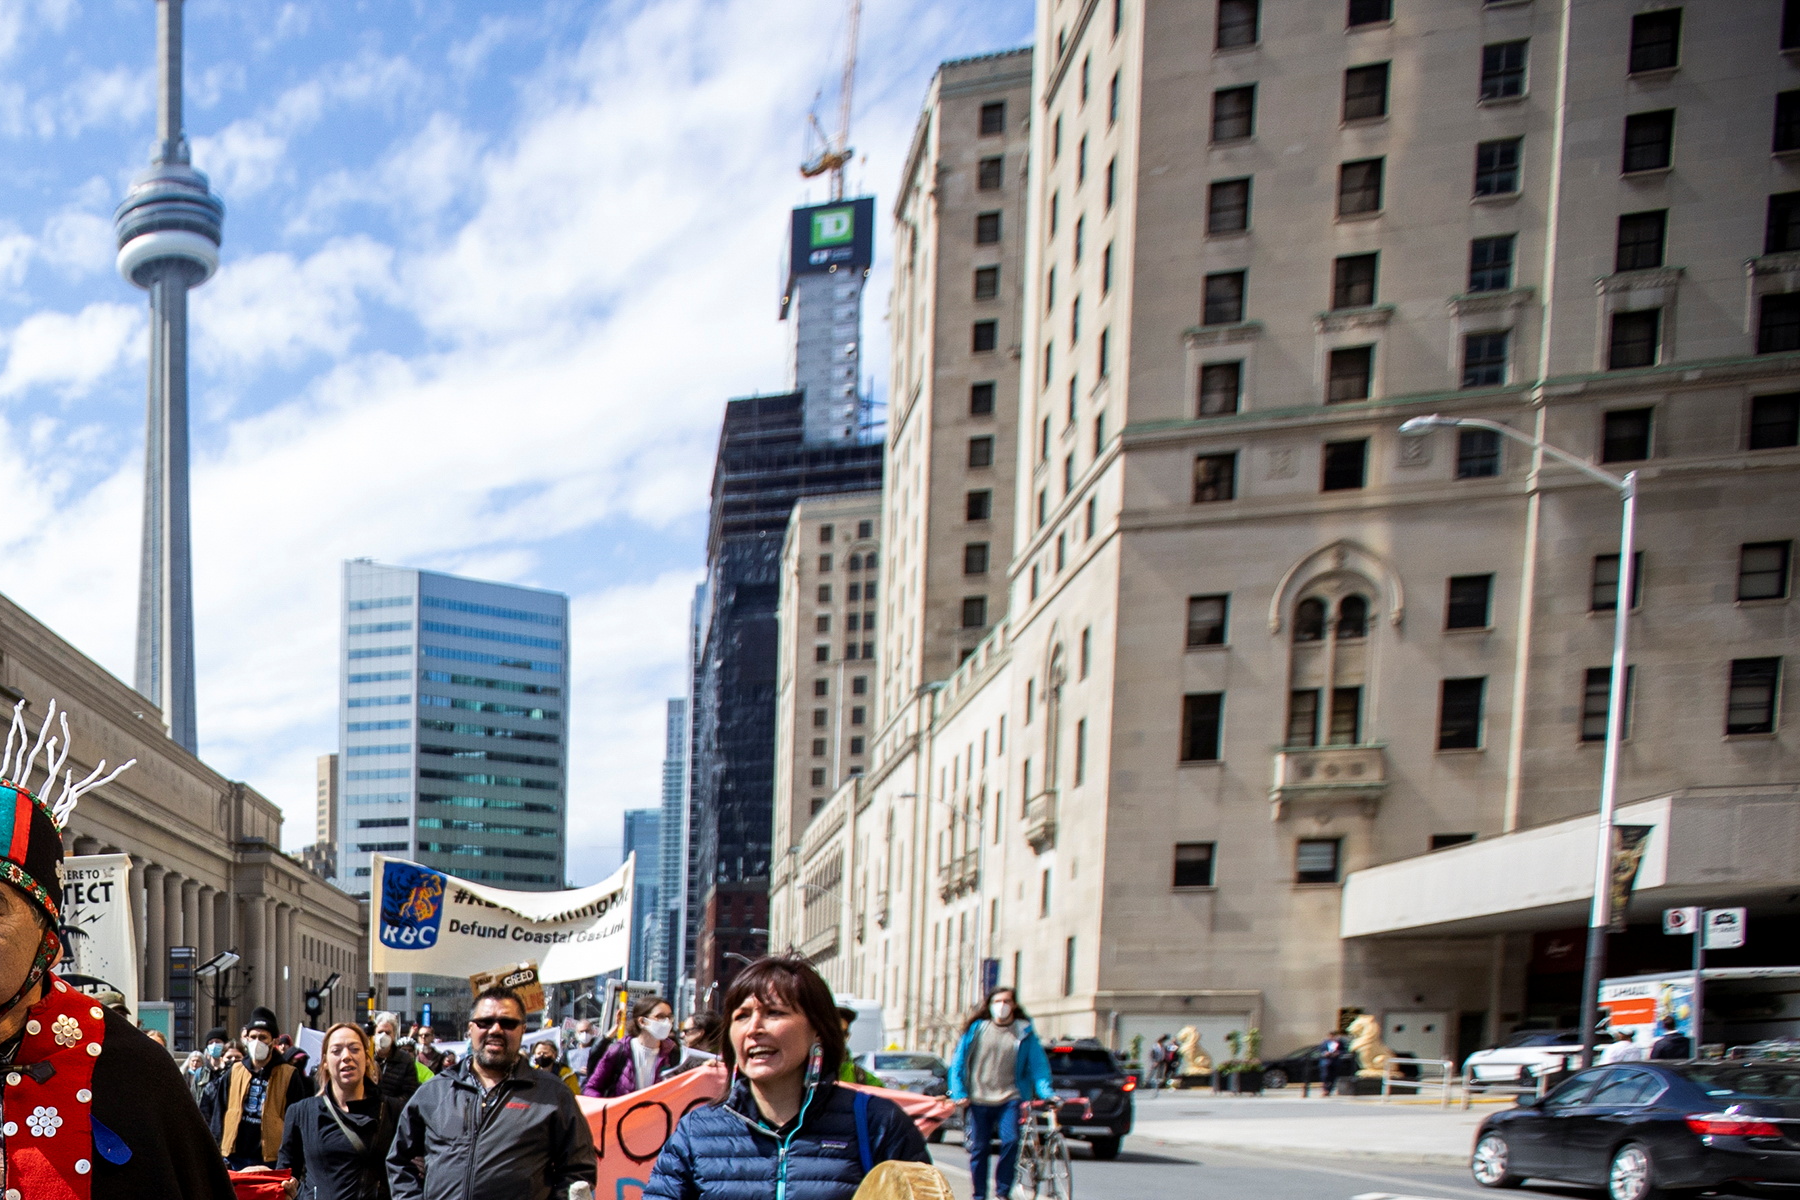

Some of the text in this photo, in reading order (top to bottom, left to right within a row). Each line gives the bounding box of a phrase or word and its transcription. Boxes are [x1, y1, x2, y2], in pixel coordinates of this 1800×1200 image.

[814, 211, 851, 240] TD
[64, 869, 100, 880] ERE TO
[63, 881, 114, 905] TECT
[383, 924, 436, 945] RBC
[449, 919, 509, 939] Defund
[511, 925, 574, 944] Coastal
[504, 969, 534, 987] GREED
